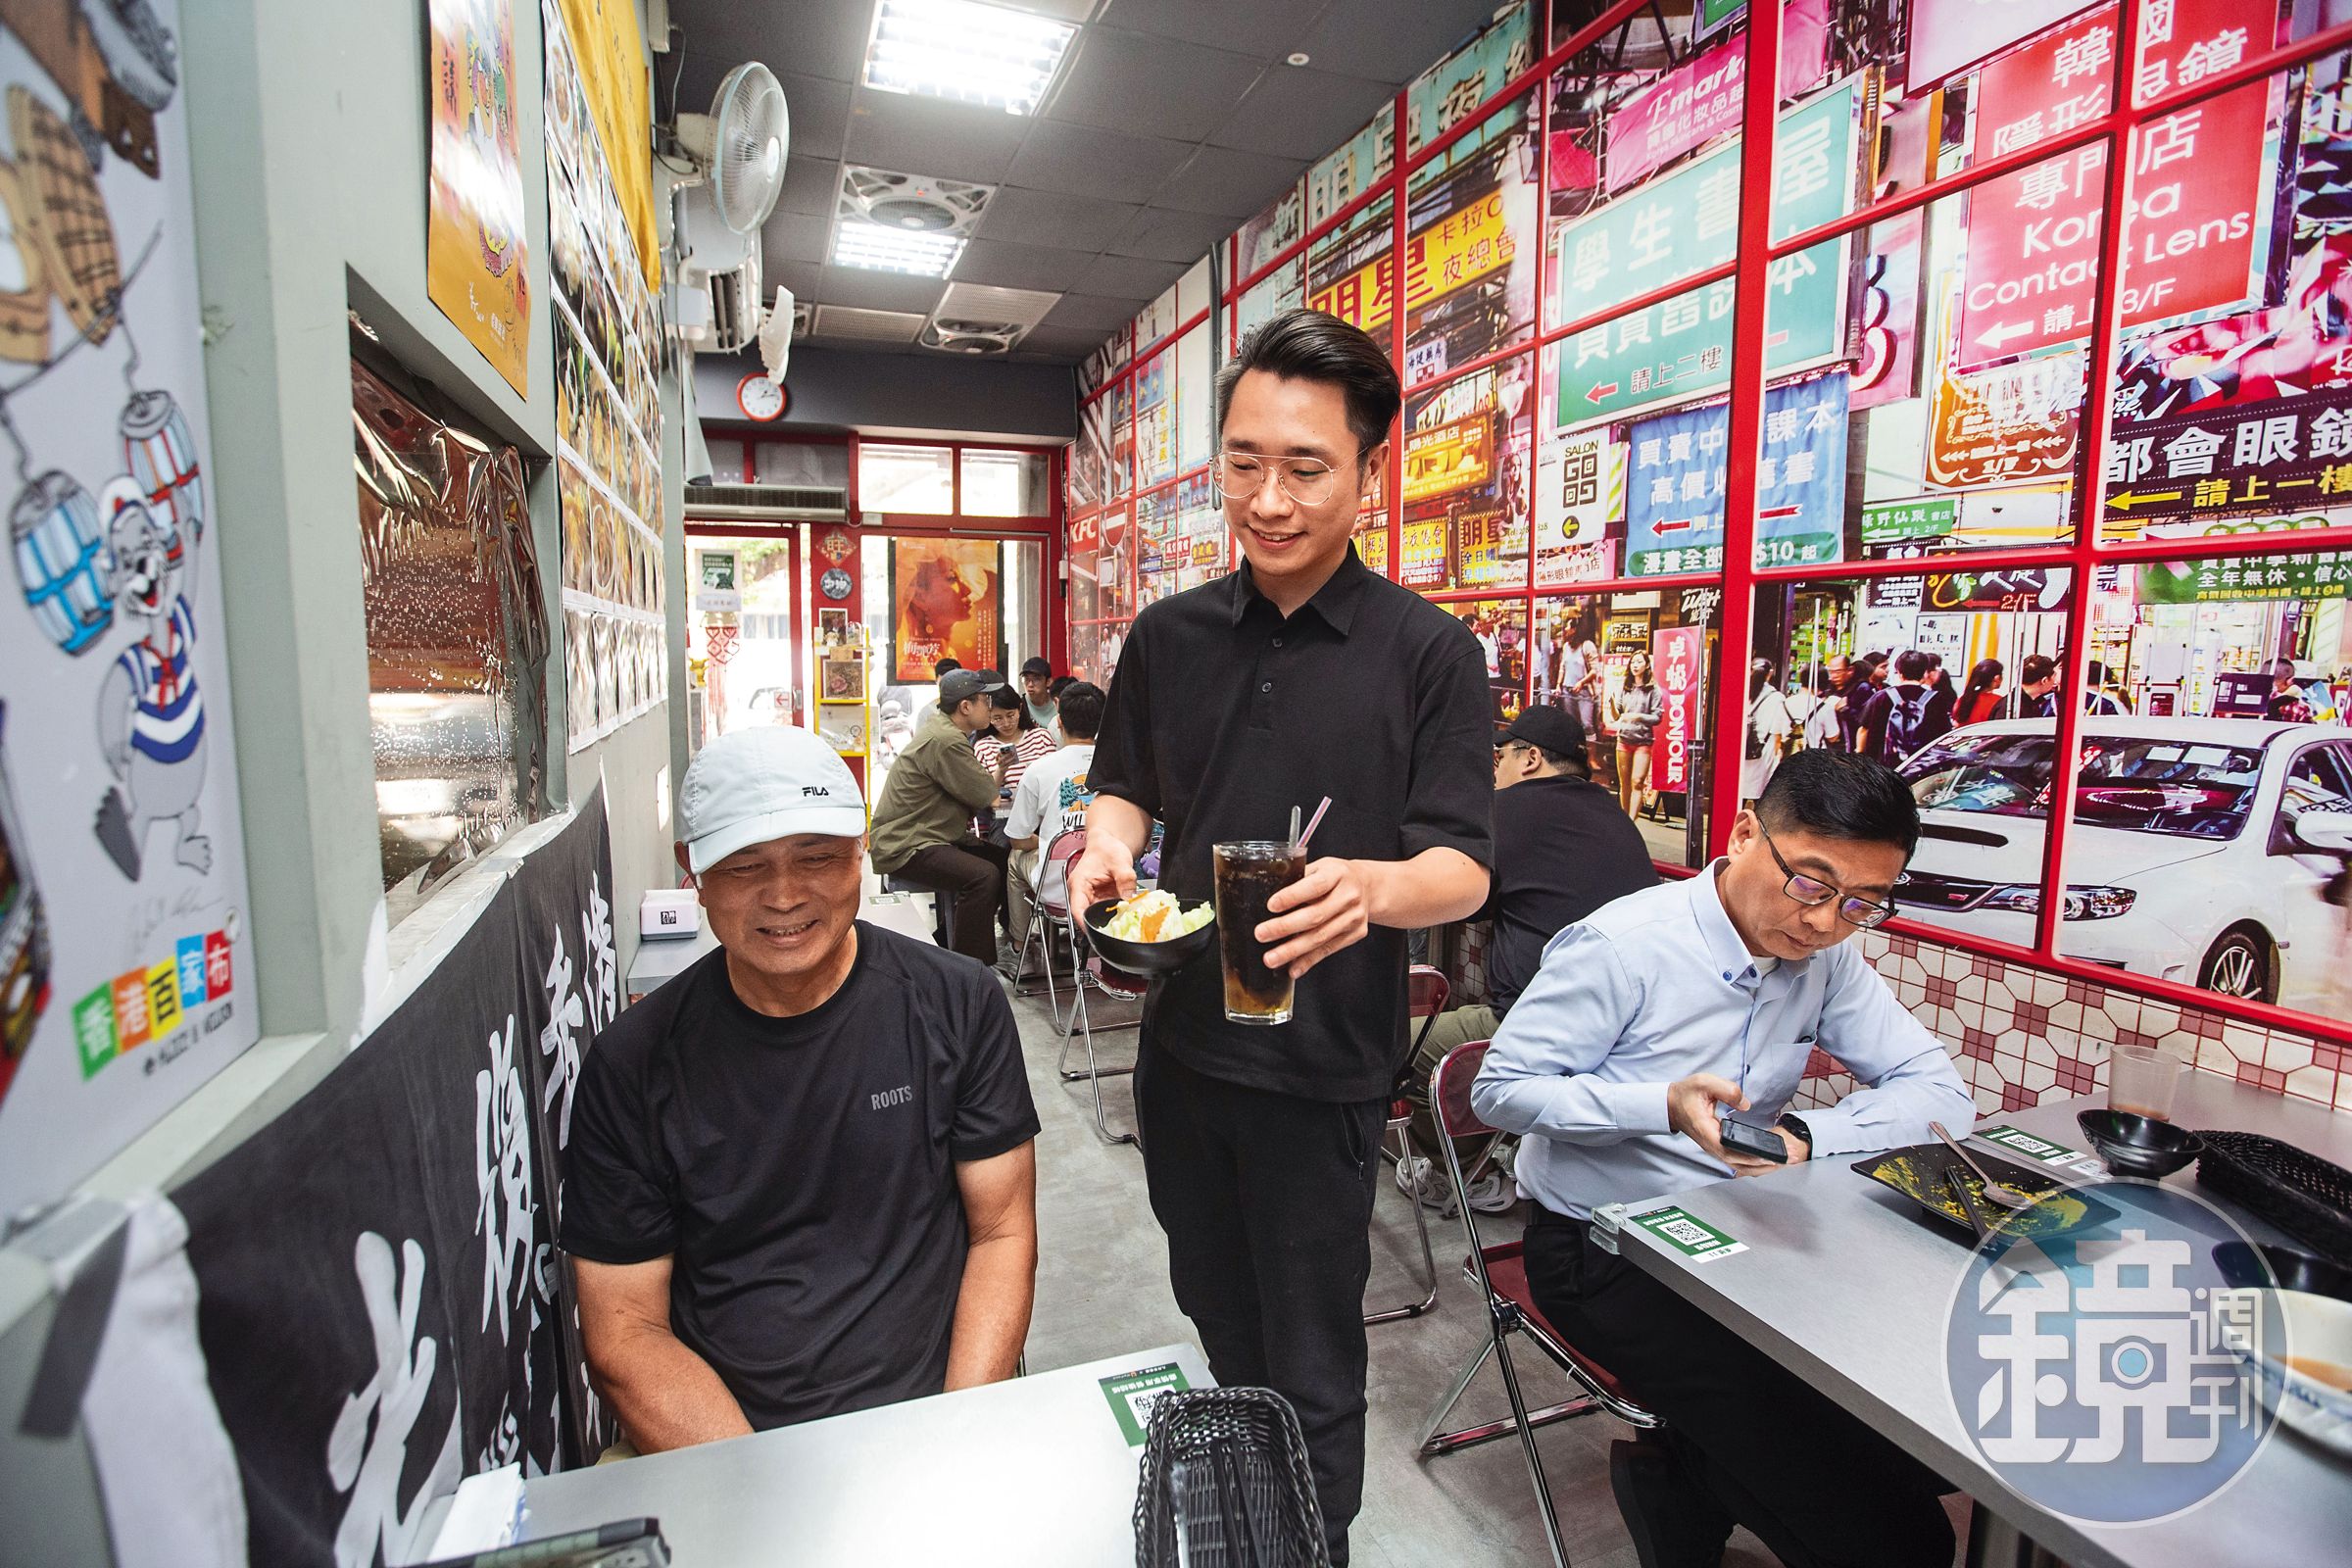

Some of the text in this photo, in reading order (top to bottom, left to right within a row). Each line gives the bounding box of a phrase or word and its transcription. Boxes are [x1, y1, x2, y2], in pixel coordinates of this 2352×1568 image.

[1573, 116, 1831, 292] 學生書屋
[2144, 212, 2249, 264] Lens
[1631, 345, 1723, 393] 請上二樓
[1565, 440, 1599, 458] SALON
[1639, 400, 1838, 469] 買賣中課本
[1070, 514, 1098, 543] KFC
[802, 786, 829, 797] FILA
[871, 1086, 913, 1110] ROOTS
